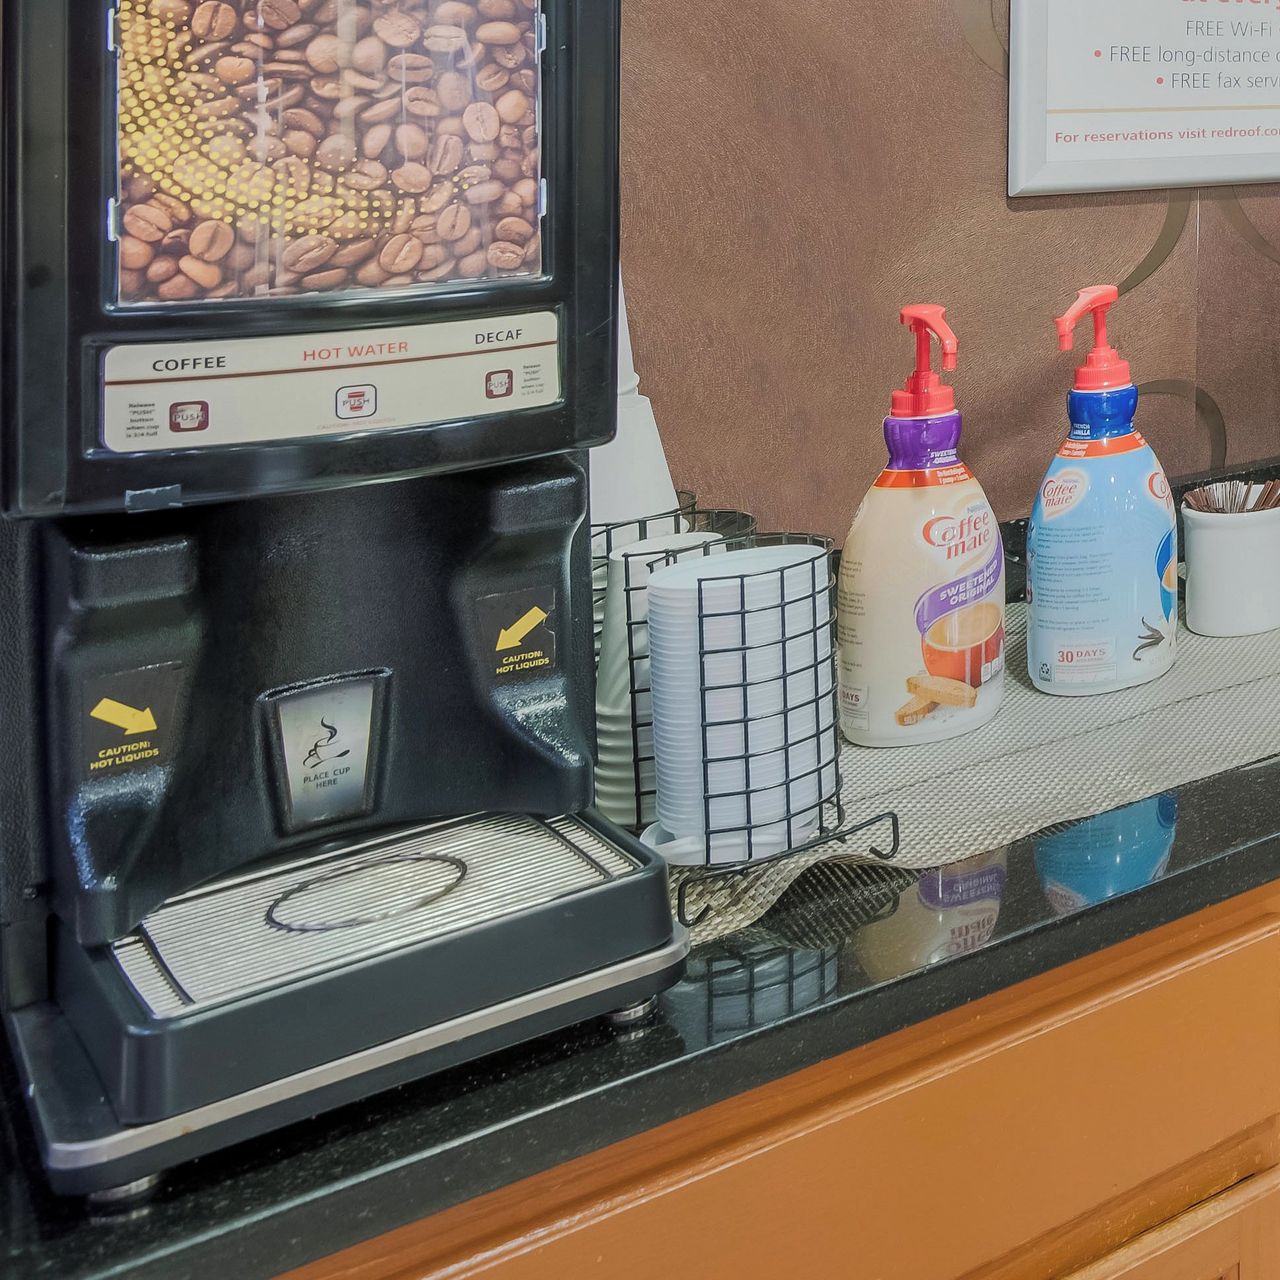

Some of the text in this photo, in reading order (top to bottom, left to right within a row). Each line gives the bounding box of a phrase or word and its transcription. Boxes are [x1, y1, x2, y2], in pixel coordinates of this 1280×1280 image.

[1186, 20, 1224, 37] FREE
[1231, 21, 1272, 38] Wi-Fi
[1110, 45, 1151, 62] FREE
[1158, 45, 1270, 66] long-distance
[1171, 73, 1211, 89] FREE
[1218, 72, 1241, 88] fax
[1055, 132, 1079, 143] For
[1084, 129, 1173, 142] reservations
[1179, 127, 1206, 139] visit
[475, 329, 522, 344] DECAF
[303, 341, 409, 361] HOT WATER
[152, 356, 226, 372] COFFEE
[1043, 479, 1078, 499] Coffee
[1045, 495, 1073, 508] mate
[922, 511, 989, 547] Coffee
[946, 527, 990, 561] mate
[939, 560, 998, 601] SWEETENED
[950, 576, 995, 606] ORIGINAL
[502, 651, 543, 664] CAUTION:
[1058, 650, 1074, 664] 30
[1076, 648, 1106, 658] DAYS
[496, 657, 550, 674] HOT LIQUIDS
[98, 741, 151, 758] CAUTION:
[90, 748, 159, 771] HOT LIQUIDS
[303, 767, 351, 784] PLACE CUP
[316, 778, 339, 789] HERE
